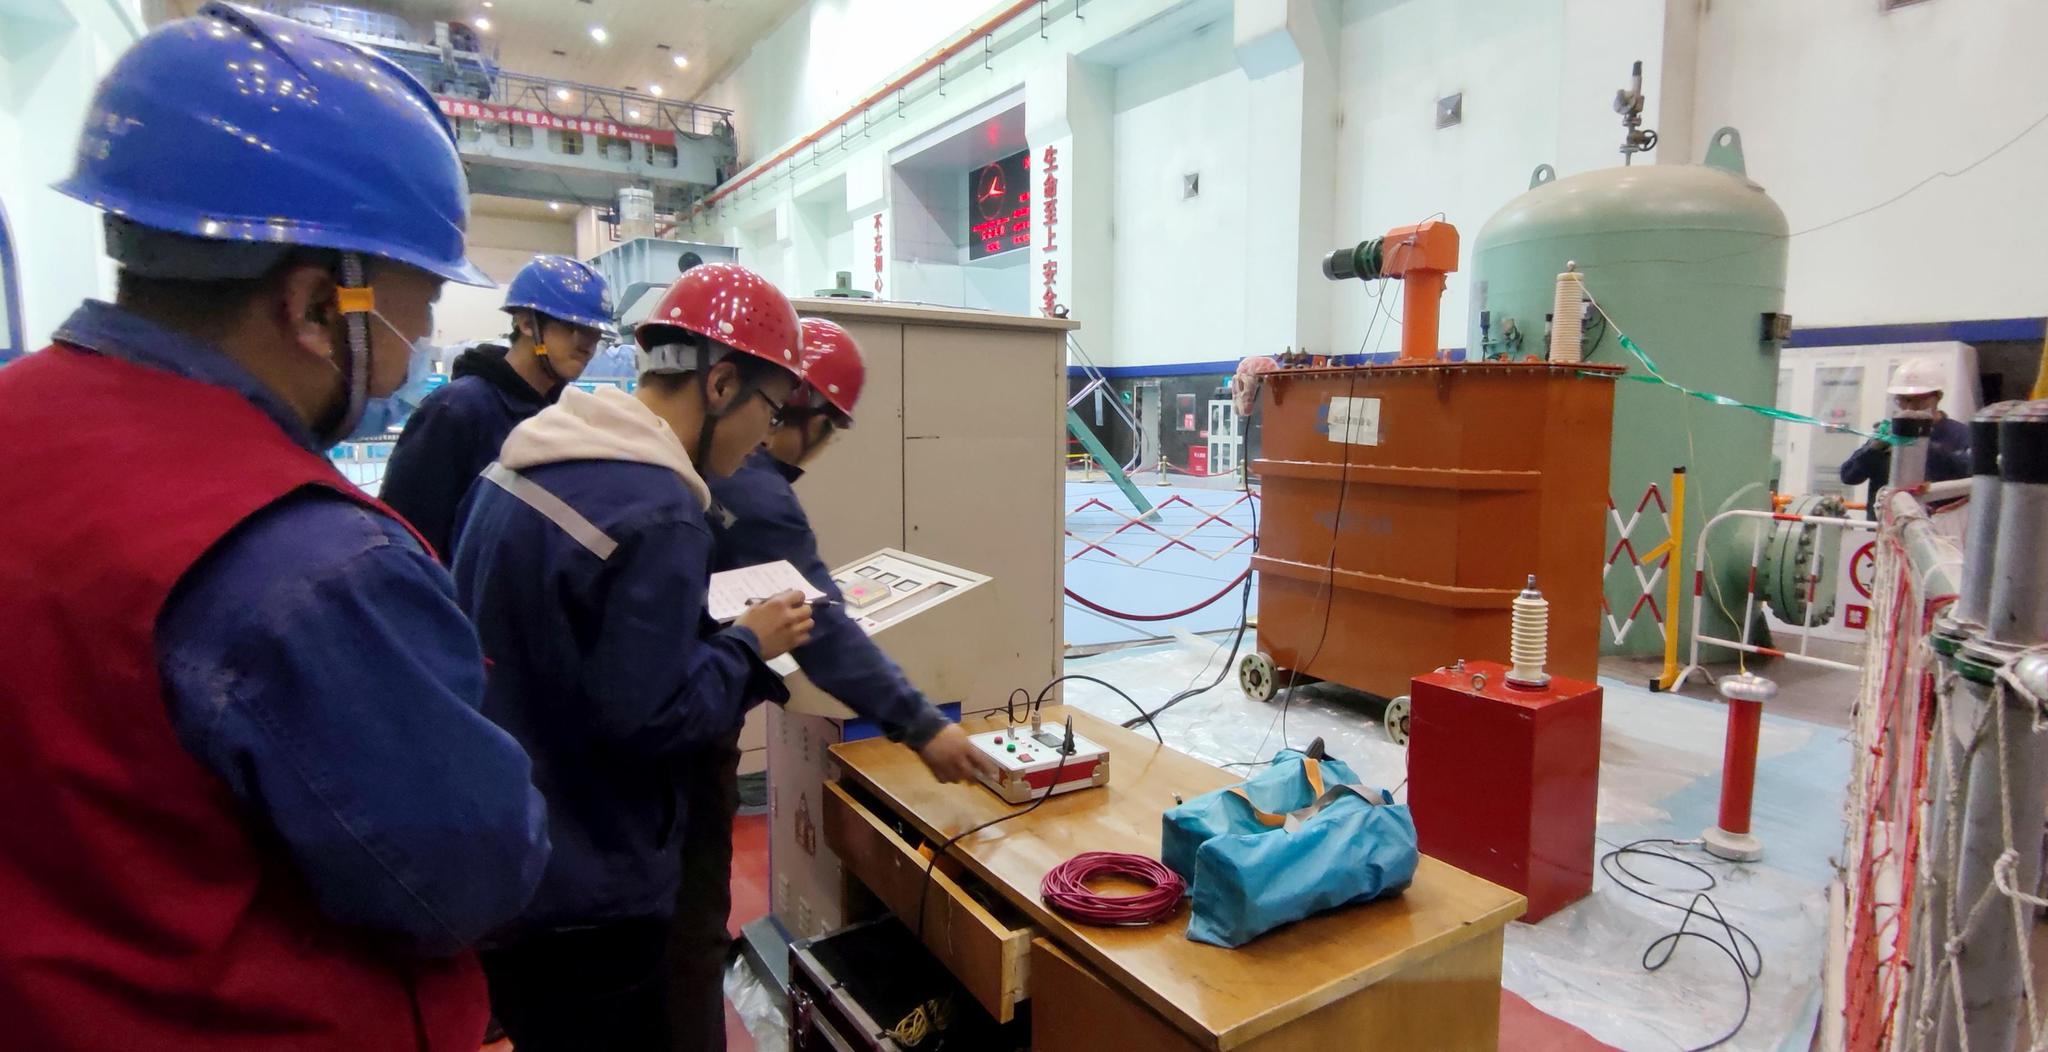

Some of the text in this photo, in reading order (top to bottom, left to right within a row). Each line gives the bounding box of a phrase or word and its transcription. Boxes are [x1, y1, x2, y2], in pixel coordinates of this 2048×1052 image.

[873, 213, 883, 303] 不忘初心
[1042, 145, 1058, 318] 生命至上 安全
